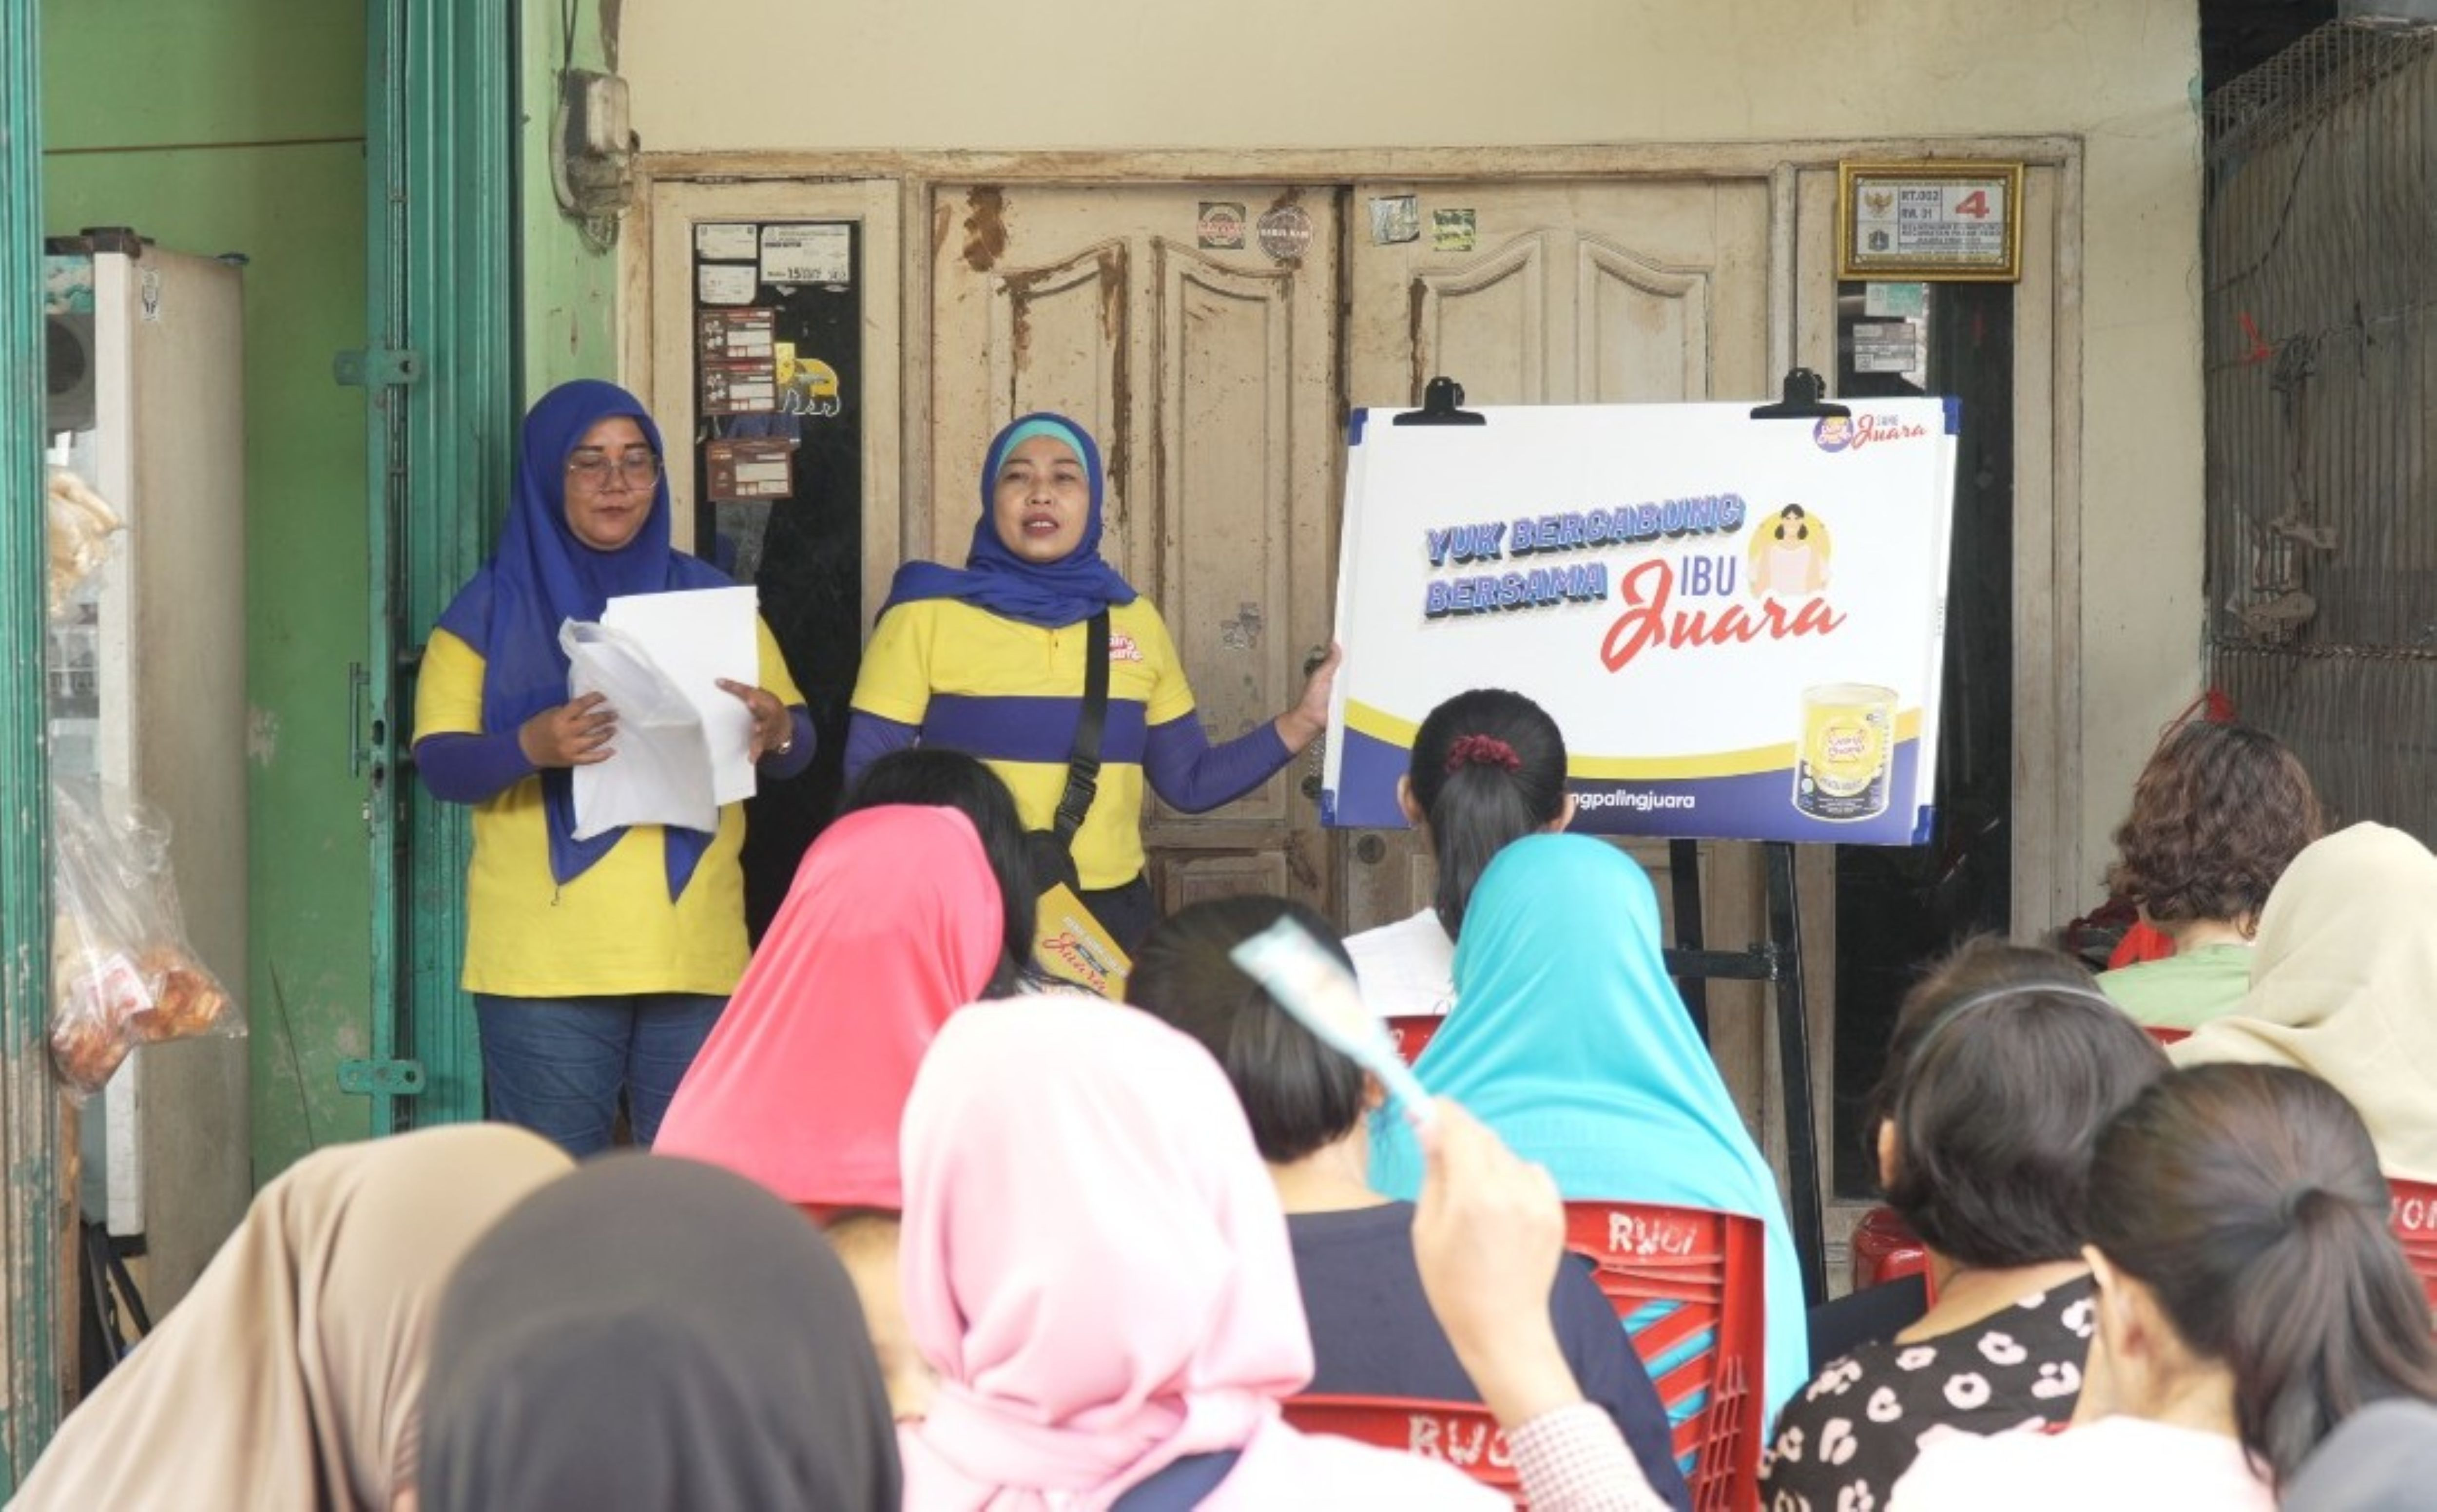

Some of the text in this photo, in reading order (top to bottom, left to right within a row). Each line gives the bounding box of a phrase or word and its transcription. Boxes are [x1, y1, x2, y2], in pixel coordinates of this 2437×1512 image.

[1955, 191, 1990, 219] 4
[1852, 414, 1928, 449] Juara
[1425, 492, 1747, 566] YUK BERGABUNG
[1425, 562, 1608, 619] BERSAMA
[1680, 555, 1737, 596] IBU
[1600, 558, 1847, 673] Juara
[1570, 789, 1695, 811] ngpalingjuara
